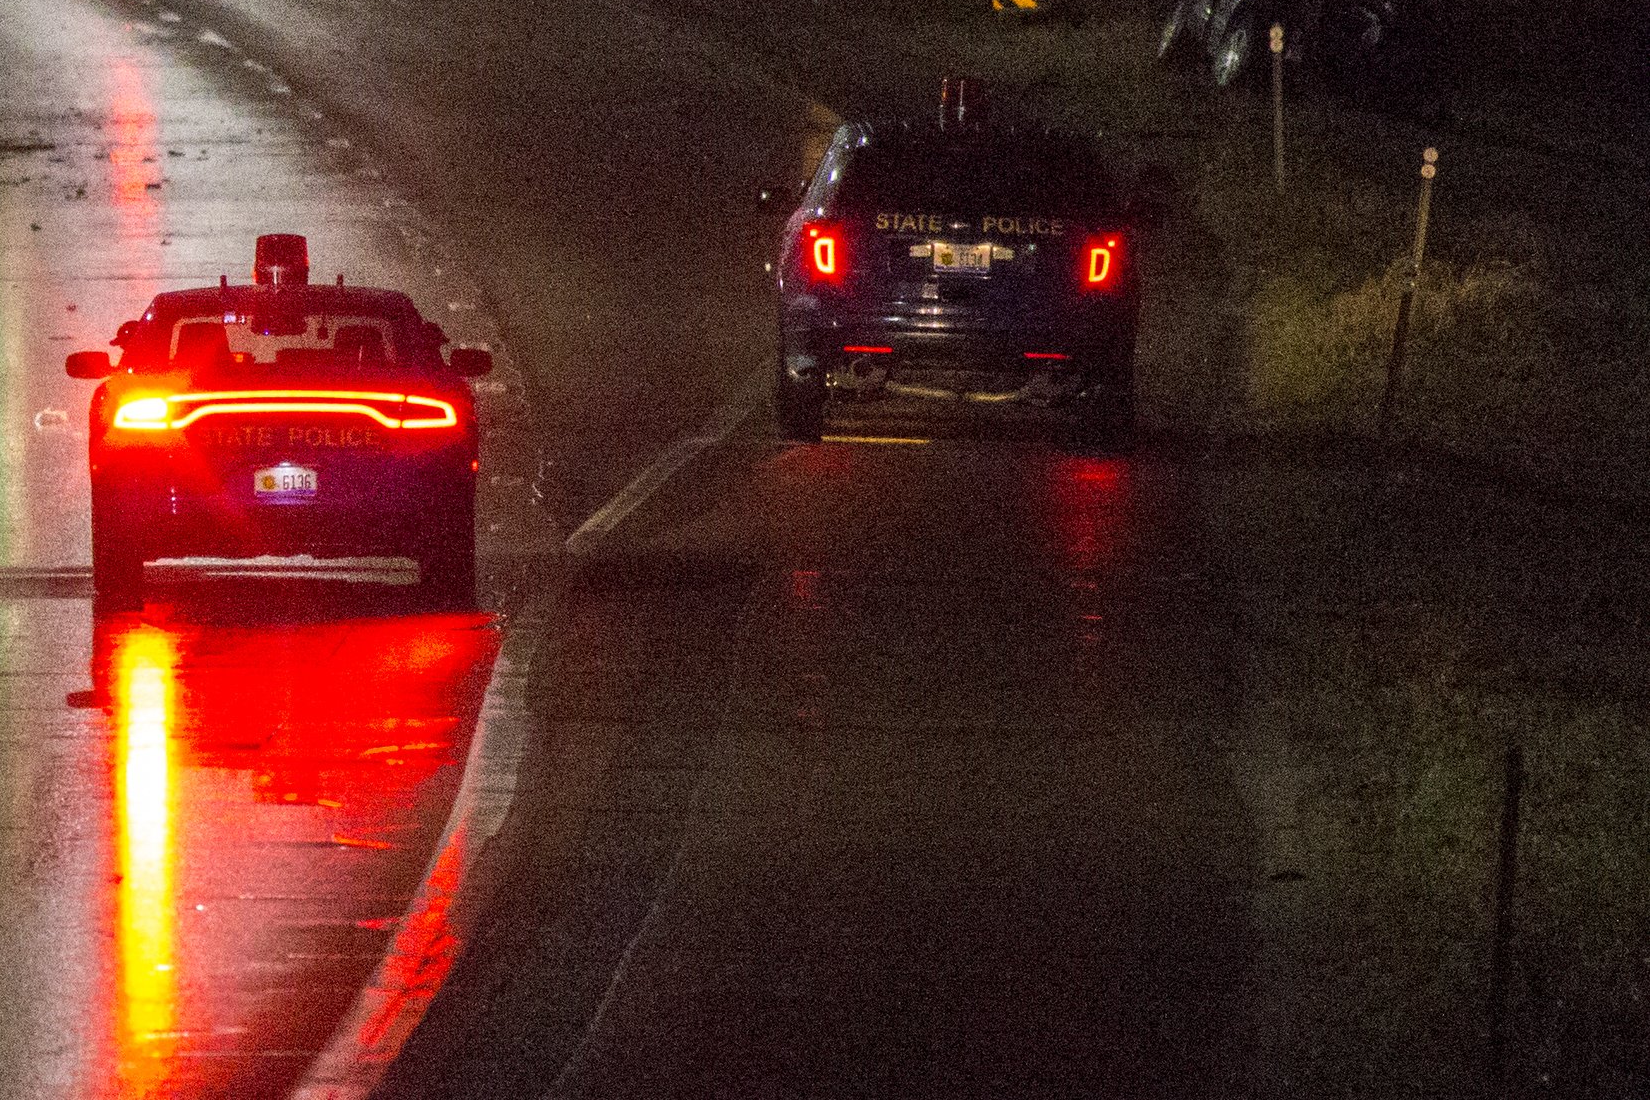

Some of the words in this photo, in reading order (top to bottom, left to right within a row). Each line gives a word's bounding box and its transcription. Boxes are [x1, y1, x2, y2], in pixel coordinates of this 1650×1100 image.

[875, 213, 943, 233] STATE
[982, 216, 1065, 236] POLICE
[202, 426, 273, 446] STATE
[288, 426, 380, 446] POLICE
[282, 473, 312, 491] 6136
